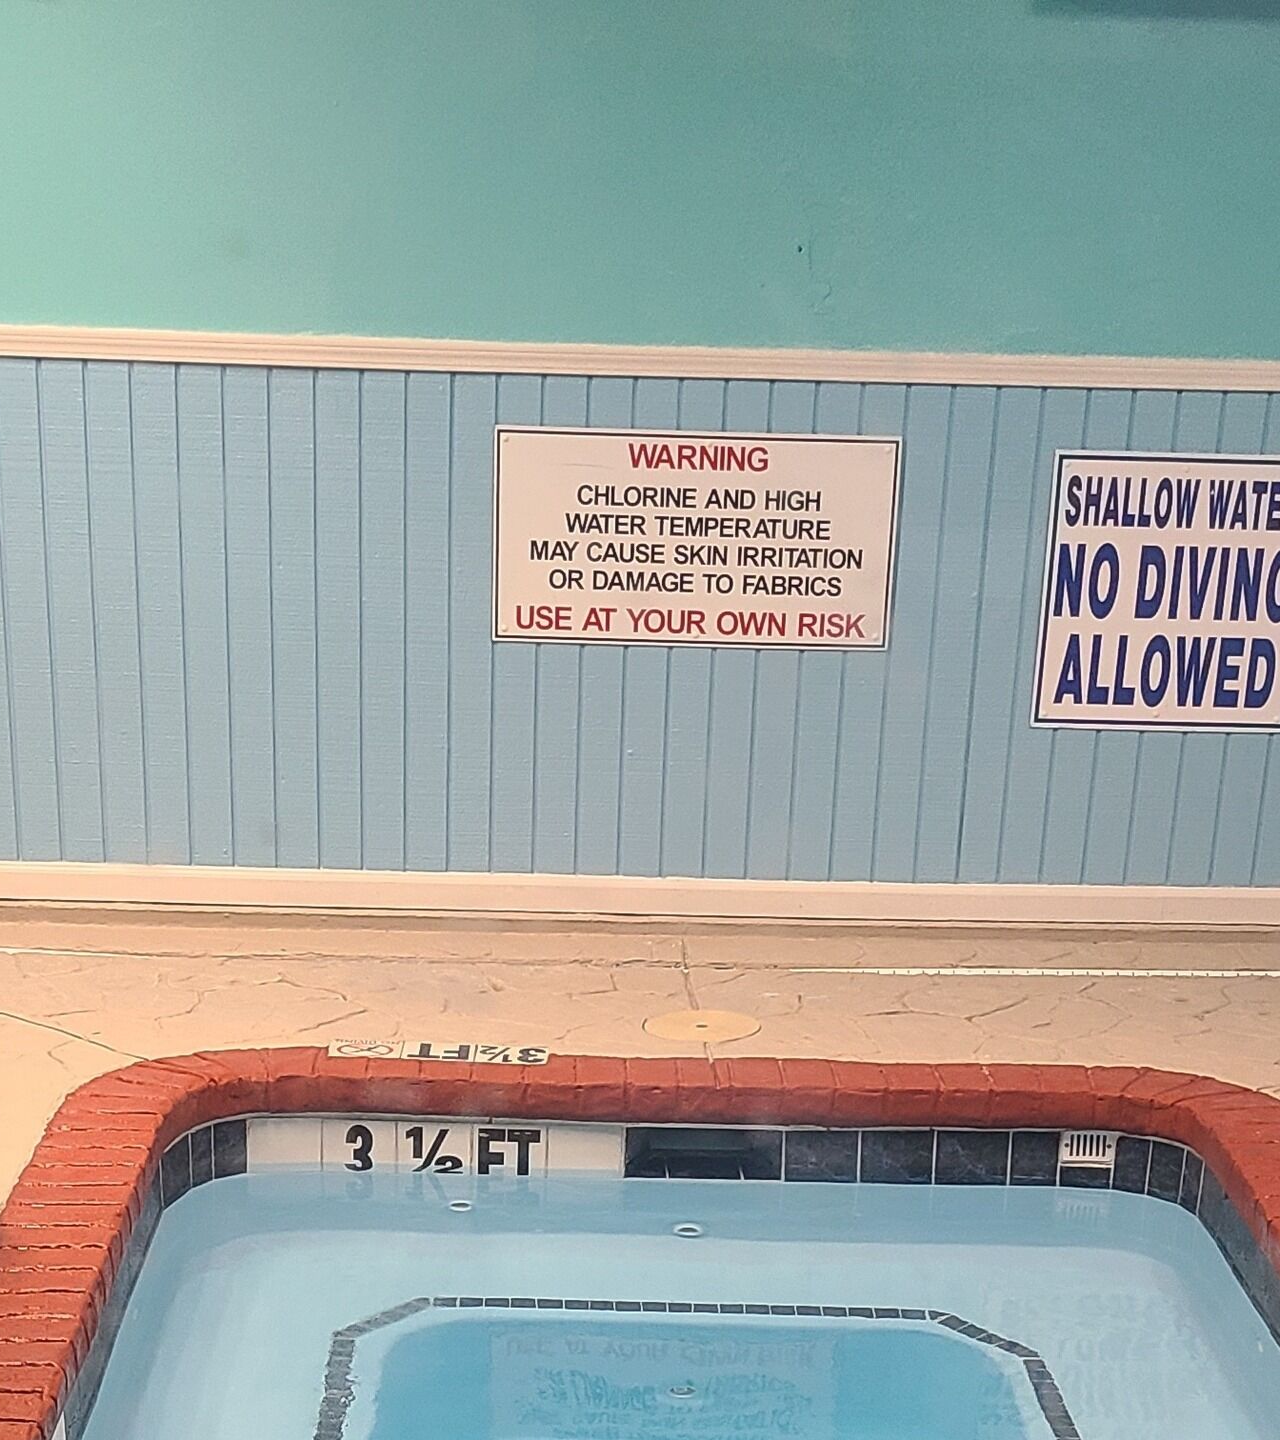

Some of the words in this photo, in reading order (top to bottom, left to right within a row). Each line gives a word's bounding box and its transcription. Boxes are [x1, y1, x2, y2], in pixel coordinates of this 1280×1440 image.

[629, 443, 768, 471] WARNING
[578, 485, 697, 508] CHLORINE
[705, 489, 755, 509] AND
[765, 490, 821, 511] HIGH
[1065, 475, 1201, 529] SHALLOW
[566, 513, 646, 535] WATER
[654, 516, 830, 540] TEMPERATURE
[531, 540, 579, 561] MAY
[587, 542, 665, 564] CAUSE
[674, 545, 728, 565] SKIN
[738, 547, 863, 569] IRRITATION
[549, 569, 584, 589] OR
[593, 571, 694, 592] DAMAGE
[703, 574, 733, 593] TO
[743, 575, 841, 596] FABRICS
[1053, 543, 1119, 619] NO
[517, 606, 572, 630] USE
[582, 608, 617, 631] AT
[627, 609, 706, 634] YOUR
[717, 611, 786, 636] OWN
[798, 613, 865, 638] RISK
[1053, 634, 1275, 708] ALLOWED
[407, 1043, 471, 1060] FT
[478, 1128, 541, 1176] FT
